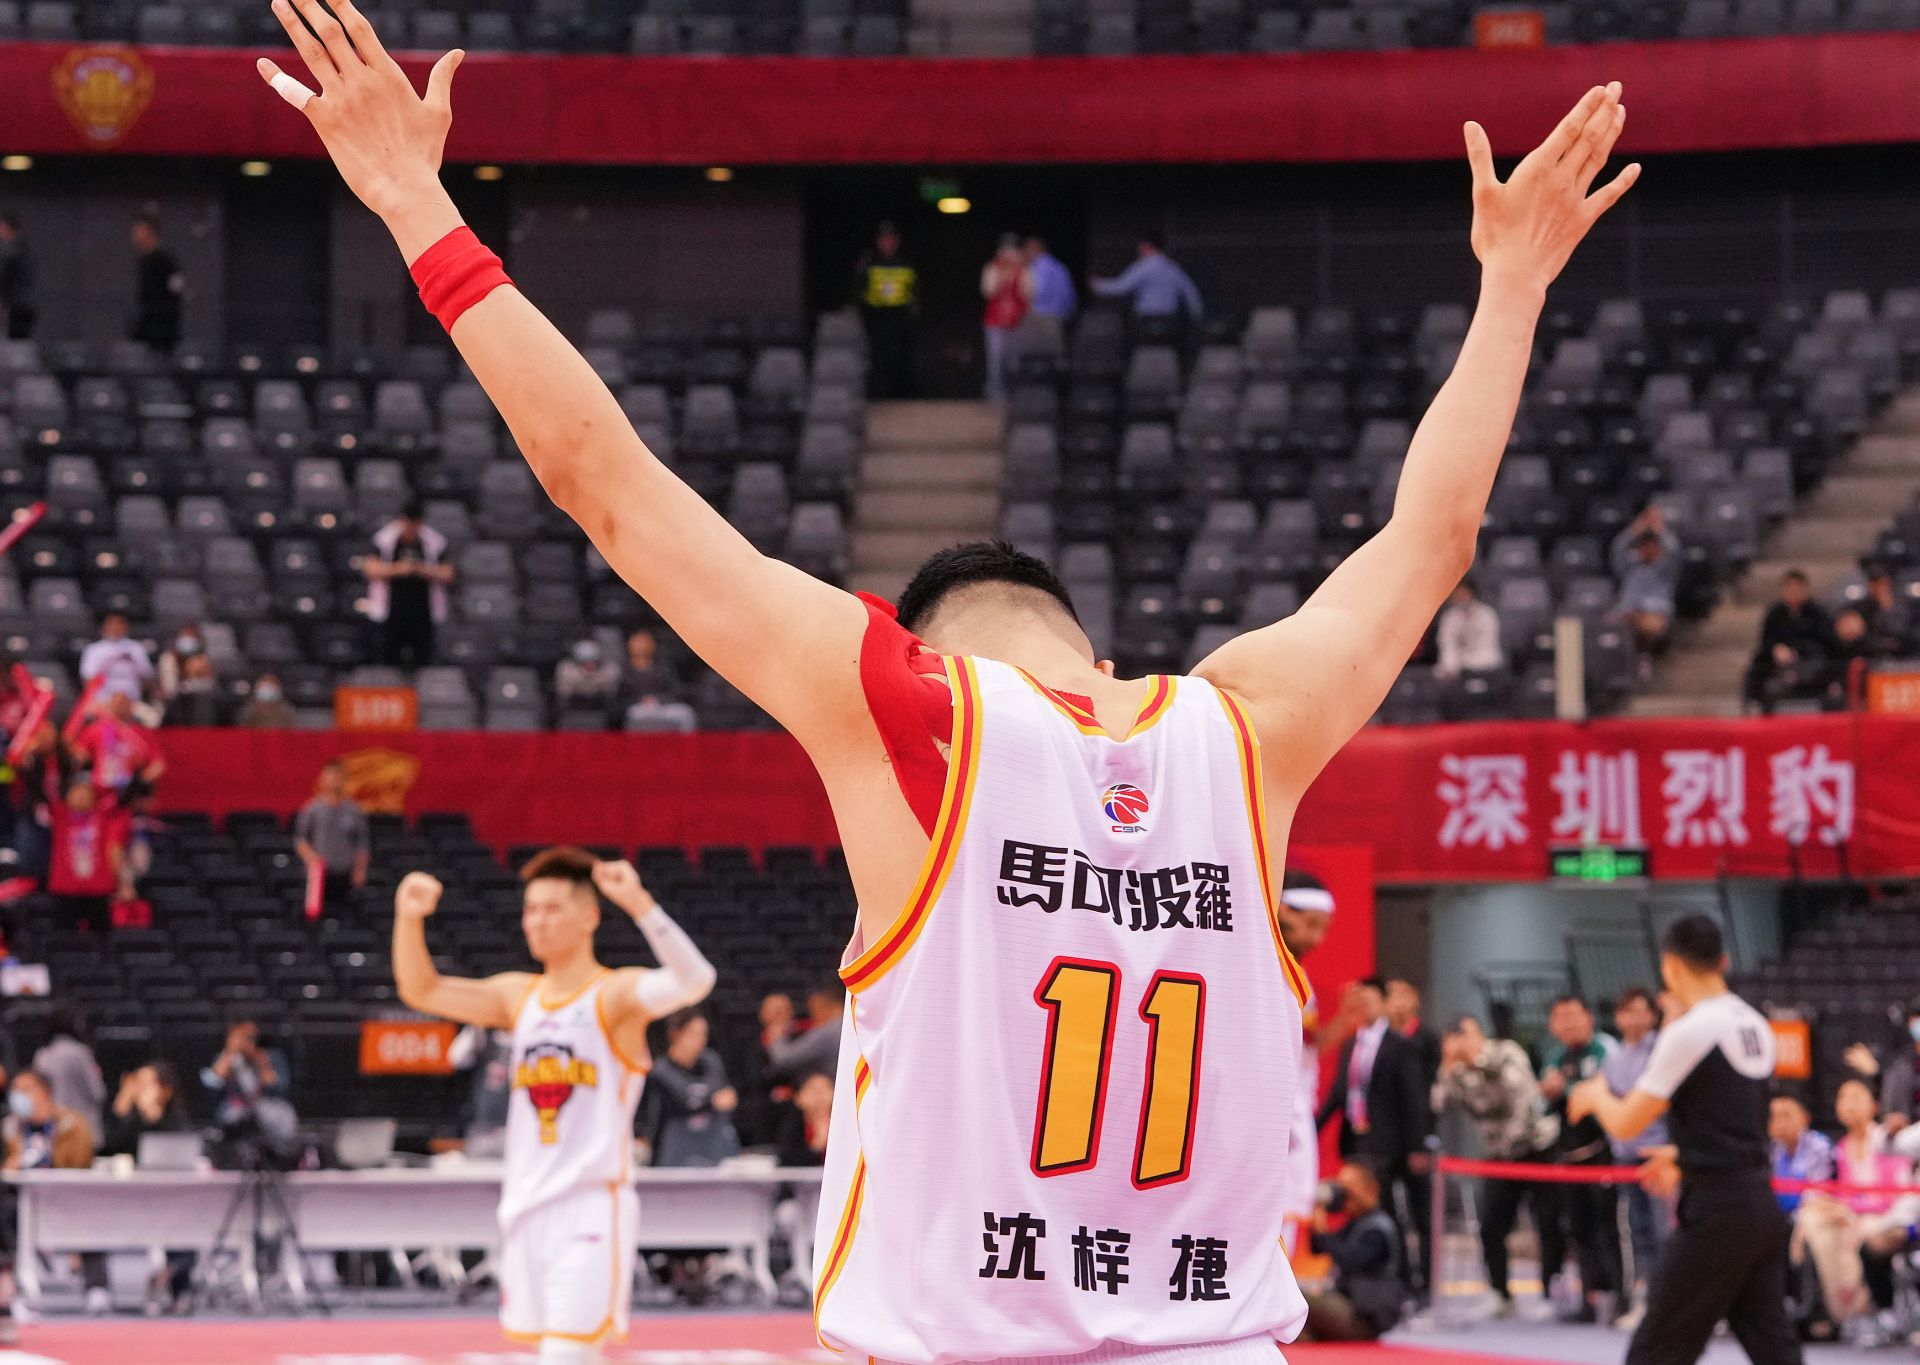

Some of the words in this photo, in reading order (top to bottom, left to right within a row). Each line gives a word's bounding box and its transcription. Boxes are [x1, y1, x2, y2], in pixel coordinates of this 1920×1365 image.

[1111, 825, 1148, 833] CBA
[1437, 745, 1855, 849] 深圳烈豹
[997, 839, 1234, 932] 馬可波羅
[1030, 955, 1207, 1191] 11
[979, 1211, 1231, 1302] 沈梓捷
